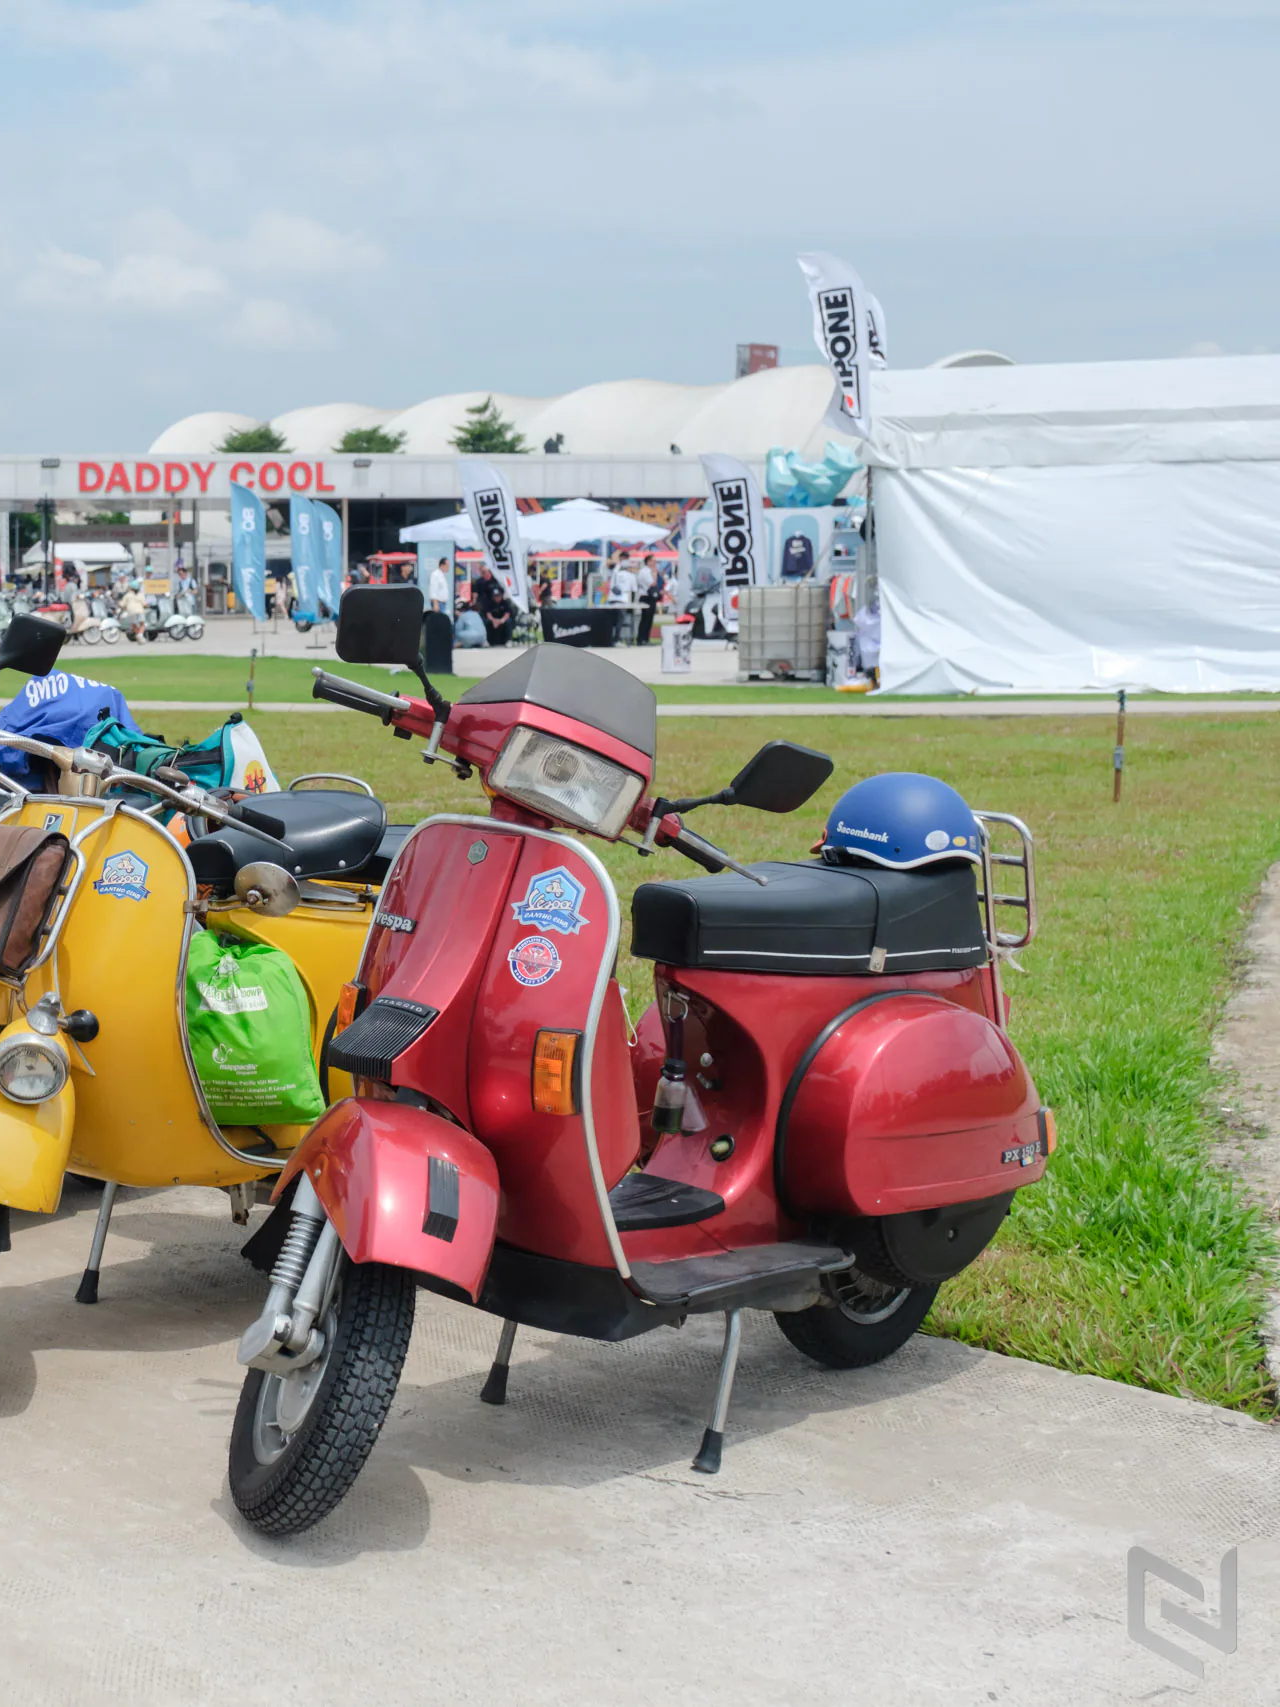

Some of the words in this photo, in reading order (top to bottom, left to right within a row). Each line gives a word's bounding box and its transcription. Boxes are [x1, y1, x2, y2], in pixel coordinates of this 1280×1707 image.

[824, 293, 853, 388] IPONE
[79, 462, 216, 493] DADDY
[230, 462, 335, 491] COOL
[480, 493, 510, 570] IPONE
[25, 672, 69, 708] CLUB
[837, 821, 889, 843] Sacombank
[101, 865, 142, 886] Vespa
[526, 888, 573, 912] Vespa
[378, 999, 422, 1012] PIAGGIO
[1004, 1149, 1019, 1163] PX
[1022, 1144, 1034, 1158] 150
